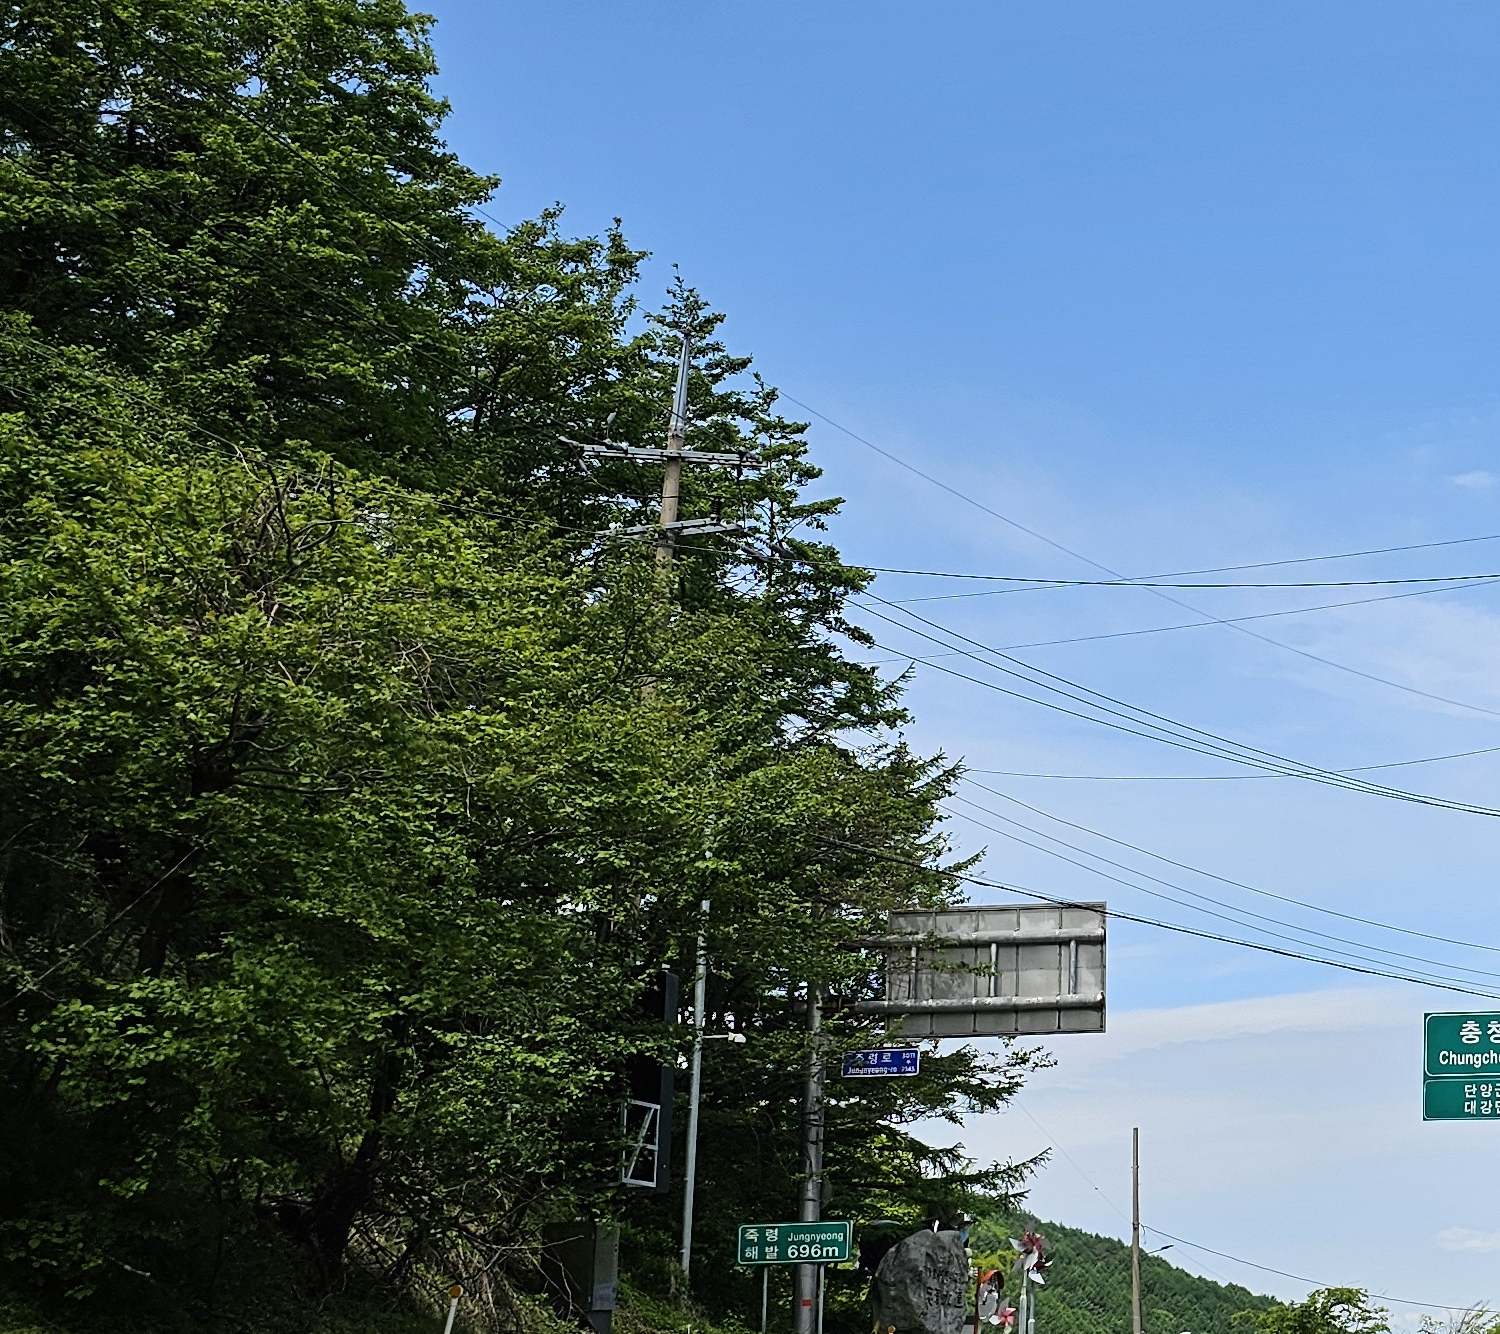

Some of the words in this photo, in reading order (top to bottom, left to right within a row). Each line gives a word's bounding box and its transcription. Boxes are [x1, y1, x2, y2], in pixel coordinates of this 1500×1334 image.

[744, 1227, 779, 1243] 죽령
[787, 1232, 844, 1243] Jungnyeong
[744, 1245, 780, 1260] 해발
[787, 1244, 839, 1259] 696m
